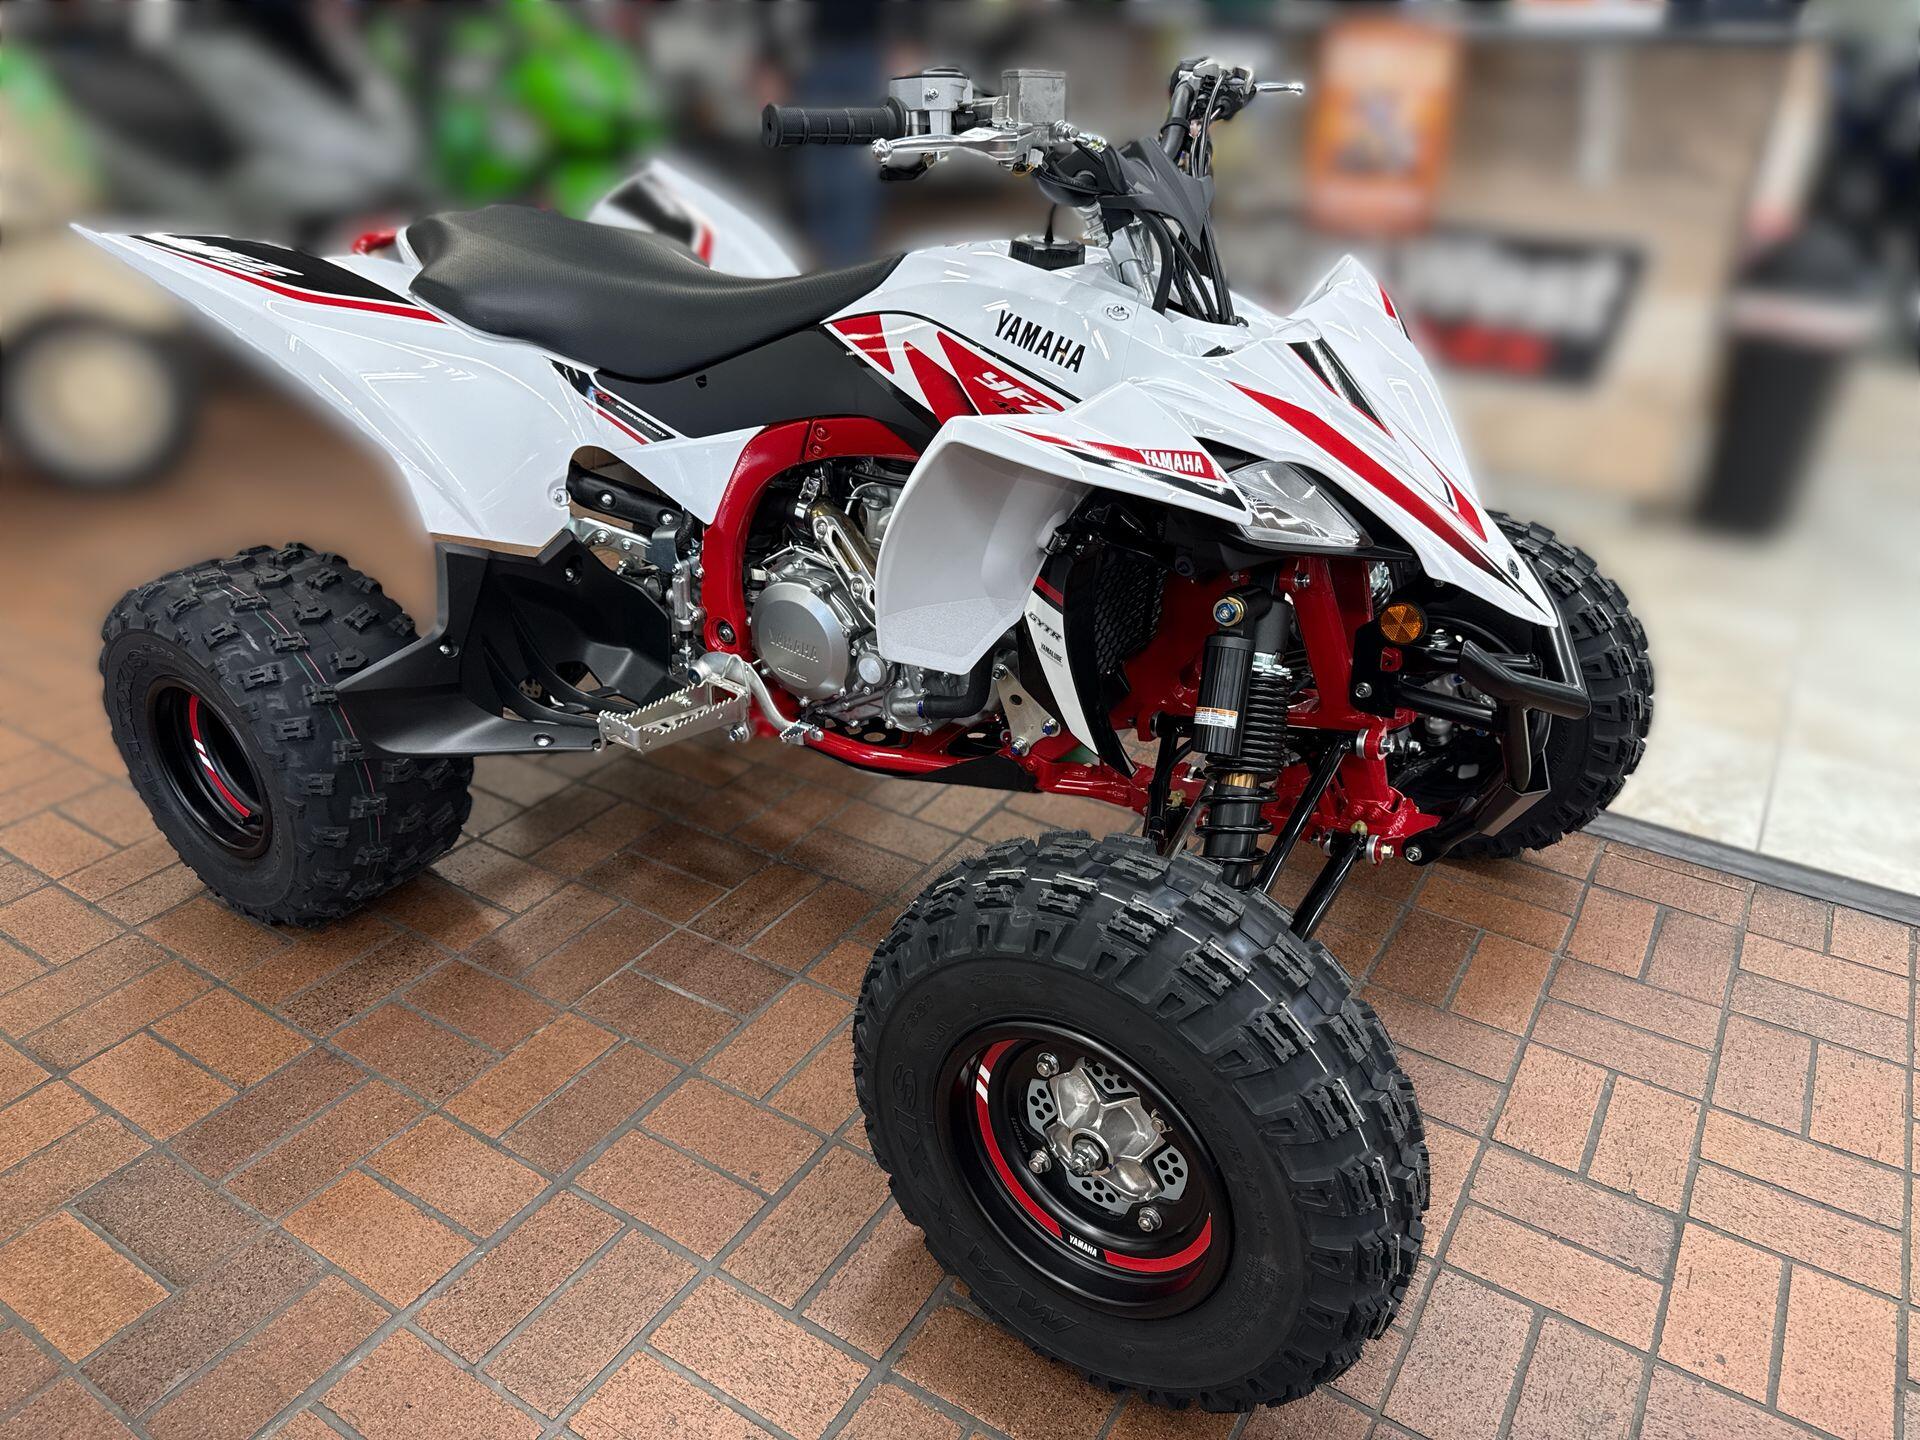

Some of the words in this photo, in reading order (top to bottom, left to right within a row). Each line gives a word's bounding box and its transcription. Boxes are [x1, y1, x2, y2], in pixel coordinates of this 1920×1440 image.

[995, 309, 1086, 373] YAMAHA
[616, 404, 667, 437] ANNIVERSARY
[1138, 449, 1205, 474] YAMAHA
[1028, 611, 1063, 642] GYTR
[768, 624, 819, 663] YAMAHA
[892, 1062, 1080, 1335] MAXXIS
[1069, 1234, 1098, 1258] YAMAHA
